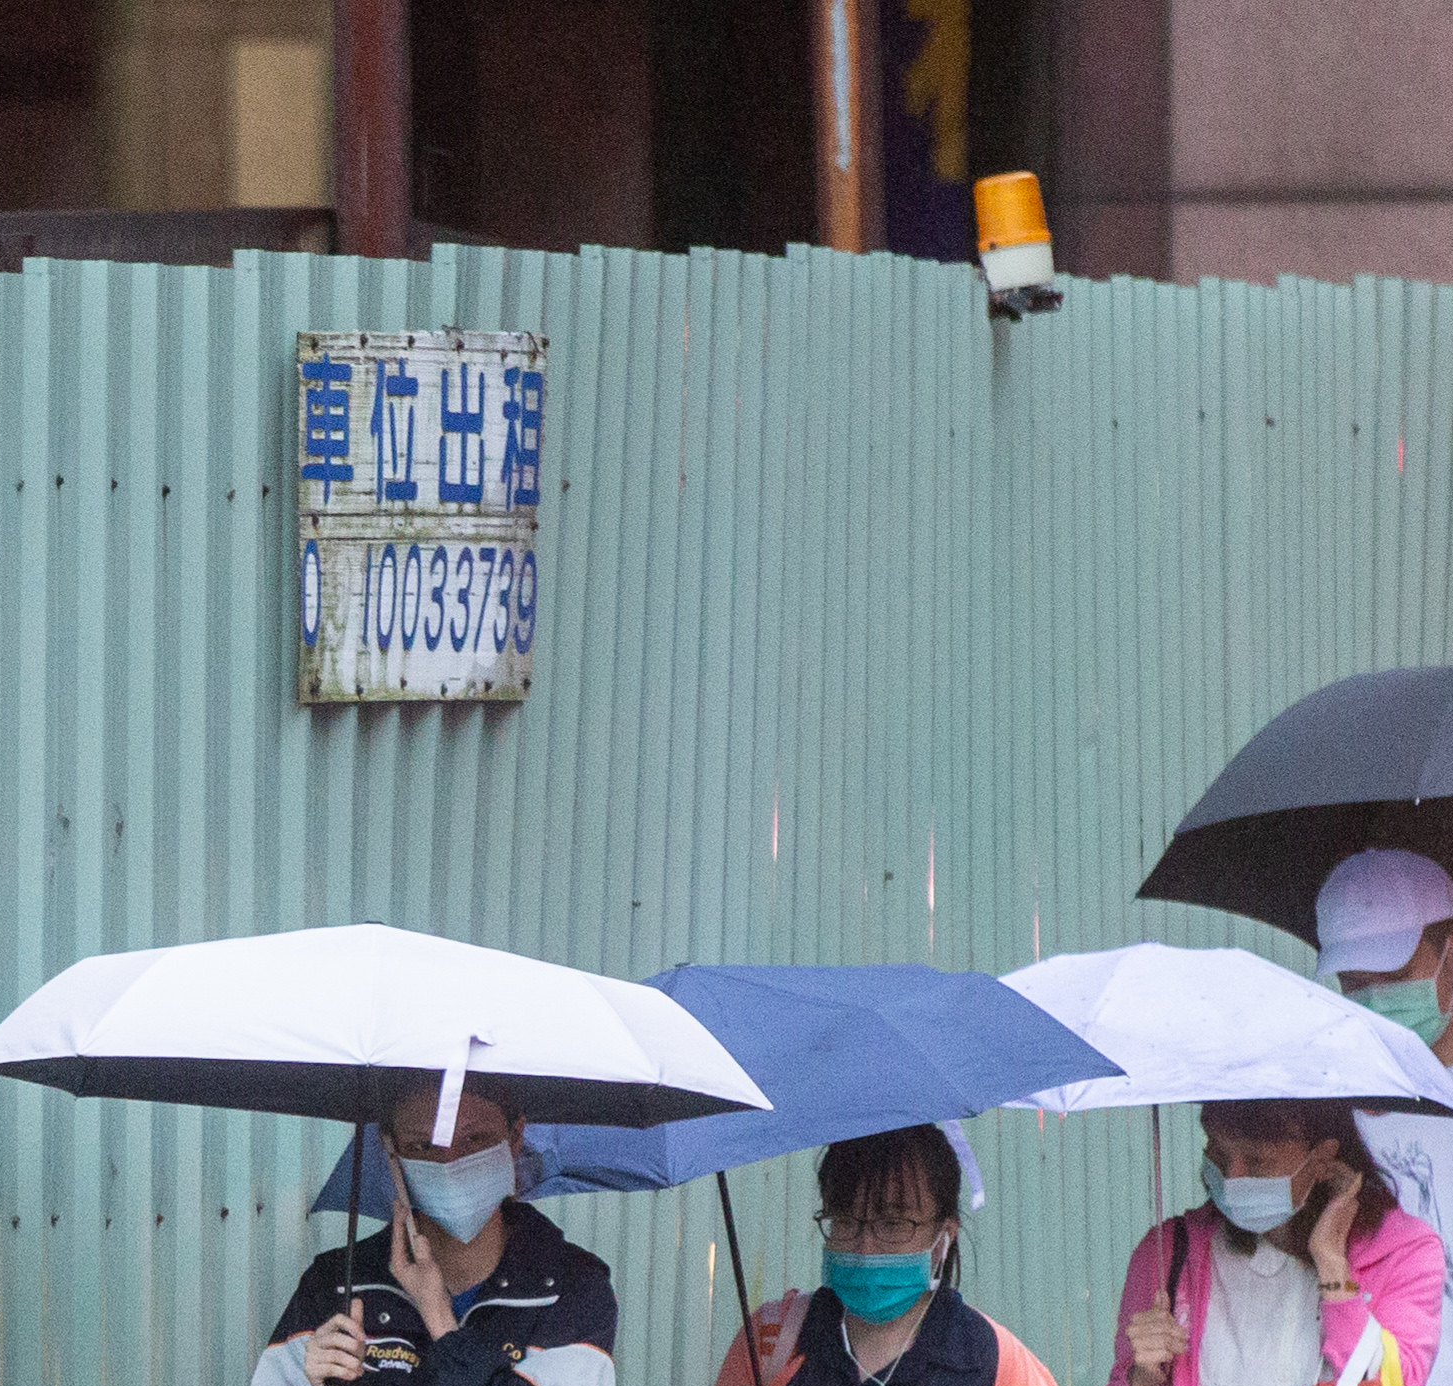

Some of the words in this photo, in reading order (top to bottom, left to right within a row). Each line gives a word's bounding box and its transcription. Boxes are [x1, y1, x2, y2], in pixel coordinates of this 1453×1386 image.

[302, 352, 543, 511] 車位出租
[367, 1345, 421, 1368] Roadway
